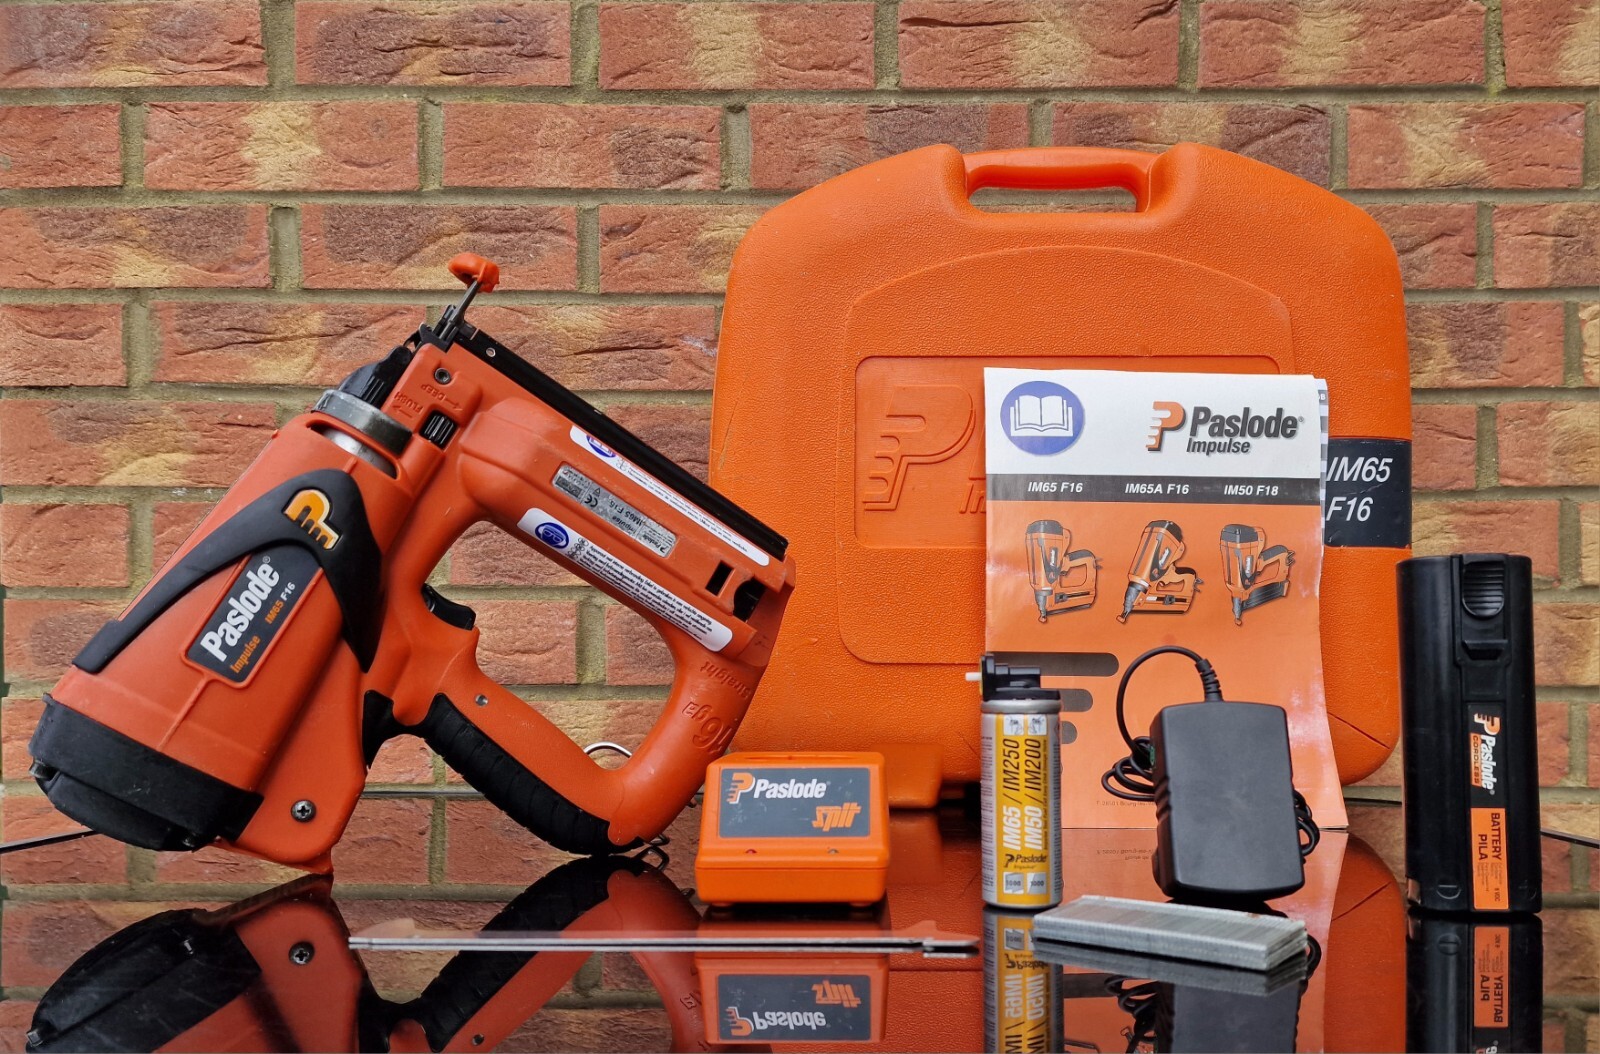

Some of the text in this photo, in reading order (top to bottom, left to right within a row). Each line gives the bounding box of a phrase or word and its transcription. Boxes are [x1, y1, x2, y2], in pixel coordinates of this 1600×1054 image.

[394, 391, 424, 414] FLUSH
[421, 383, 447, 401] DEEP
[1190, 406, 1298, 438] Paslode
[1187, 438, 1251, 456] Impulse
[1326, 457, 1393, 482] IM65
[1027, 481, 1084, 493] IM65 F16
[1125, 482, 1190, 495] IM65A F16
[1223, 485, 1279, 496] IM50 F18
[1326, 496, 1374, 522] F16
[200, 563, 280, 662] Paslode
[265, 581, 296, 624] IM65 F16
[230, 635, 261, 674] Impulse
[700, 661, 752, 700] Straight
[1003, 738, 1020, 791] IM250
[1025, 738, 1041, 791] IM200
[1472, 735, 1480, 784] CORDLESS
[1480, 735, 1497, 791] Paslode
[754, 778, 827, 799] Paslode
[1002, 805, 1022, 850] IM65
[1024, 805, 1043, 850] IM50
[1491, 812, 1501, 860] BATTERY
[1015, 854, 1047, 863] Paslode
[1478, 834, 1488, 860] PILA
